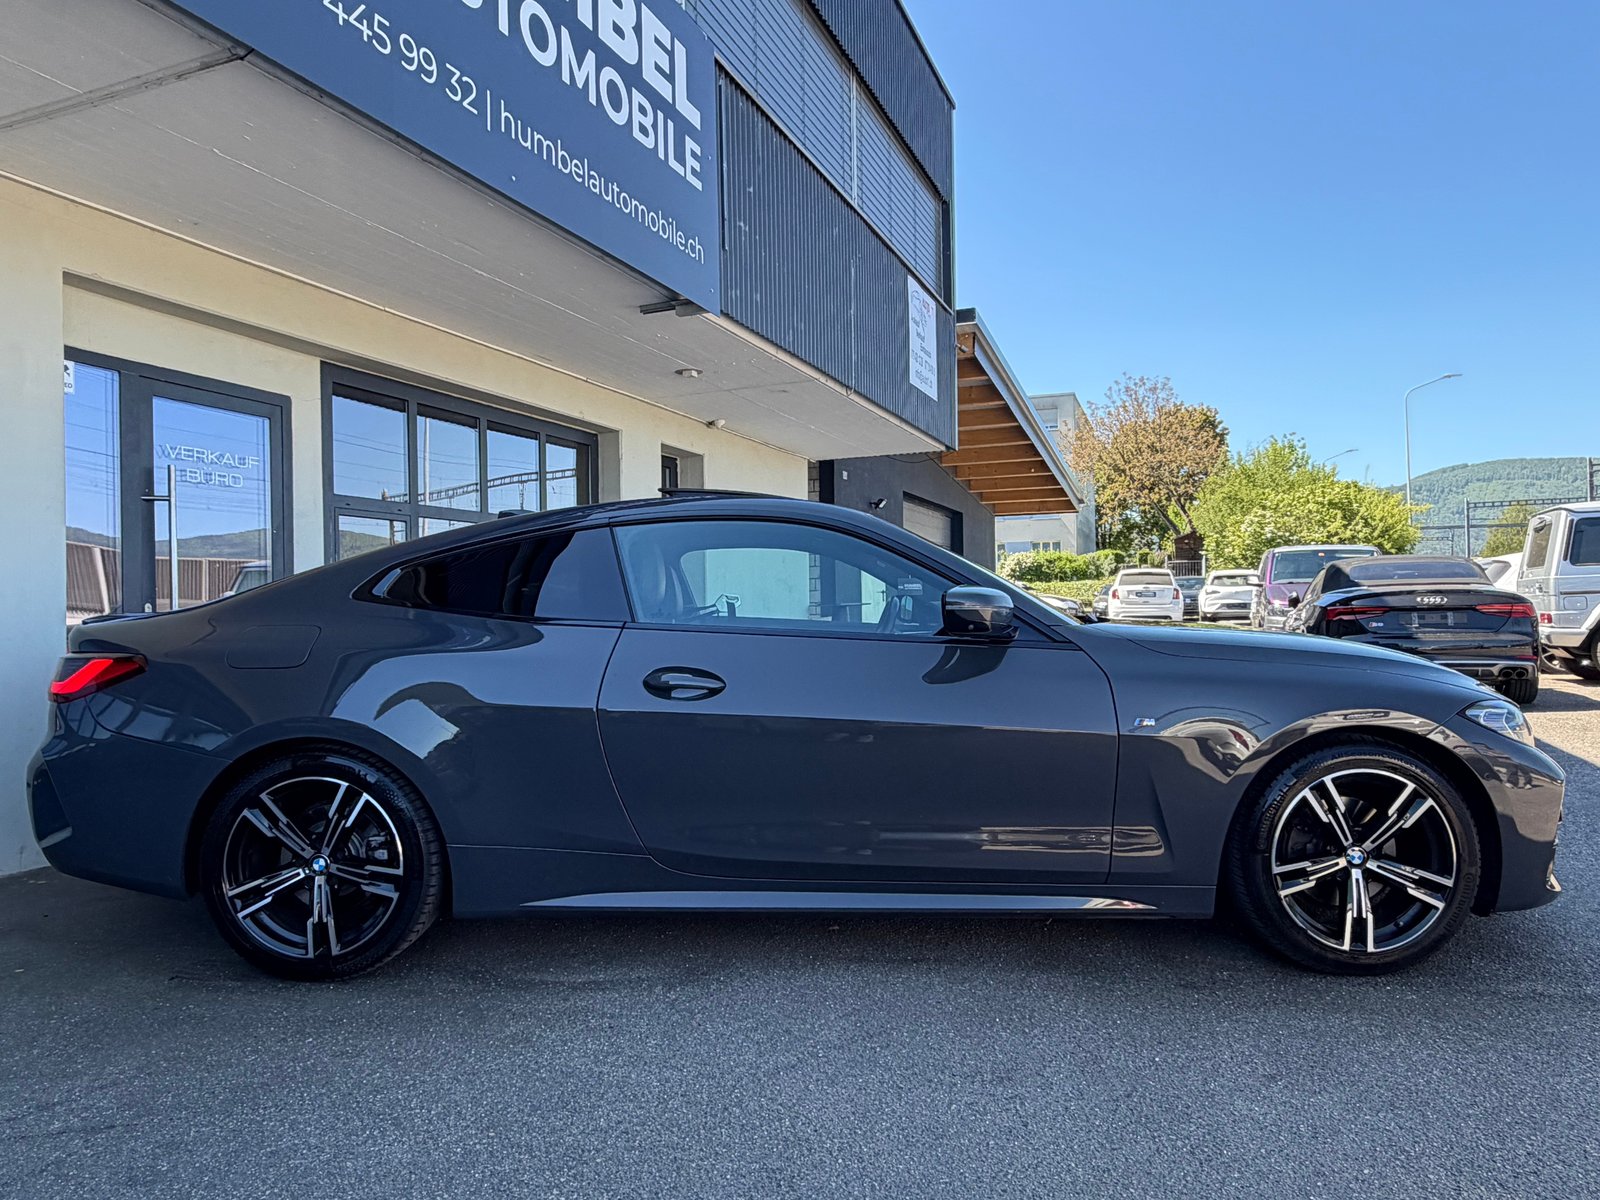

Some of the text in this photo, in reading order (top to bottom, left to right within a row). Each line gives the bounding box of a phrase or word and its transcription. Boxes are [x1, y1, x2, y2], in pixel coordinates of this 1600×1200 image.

[323, 0, 391, 55] 445
[400, 33, 437, 84] 99
[446, 62, 478, 115] 32
[500, 99, 705, 264] humbelautomobile.ch
[461, 0, 702, 191] OMOBILE
[166, 443, 260, 469] VERKAUF
[186, 466, 244, 488] BÜRO
